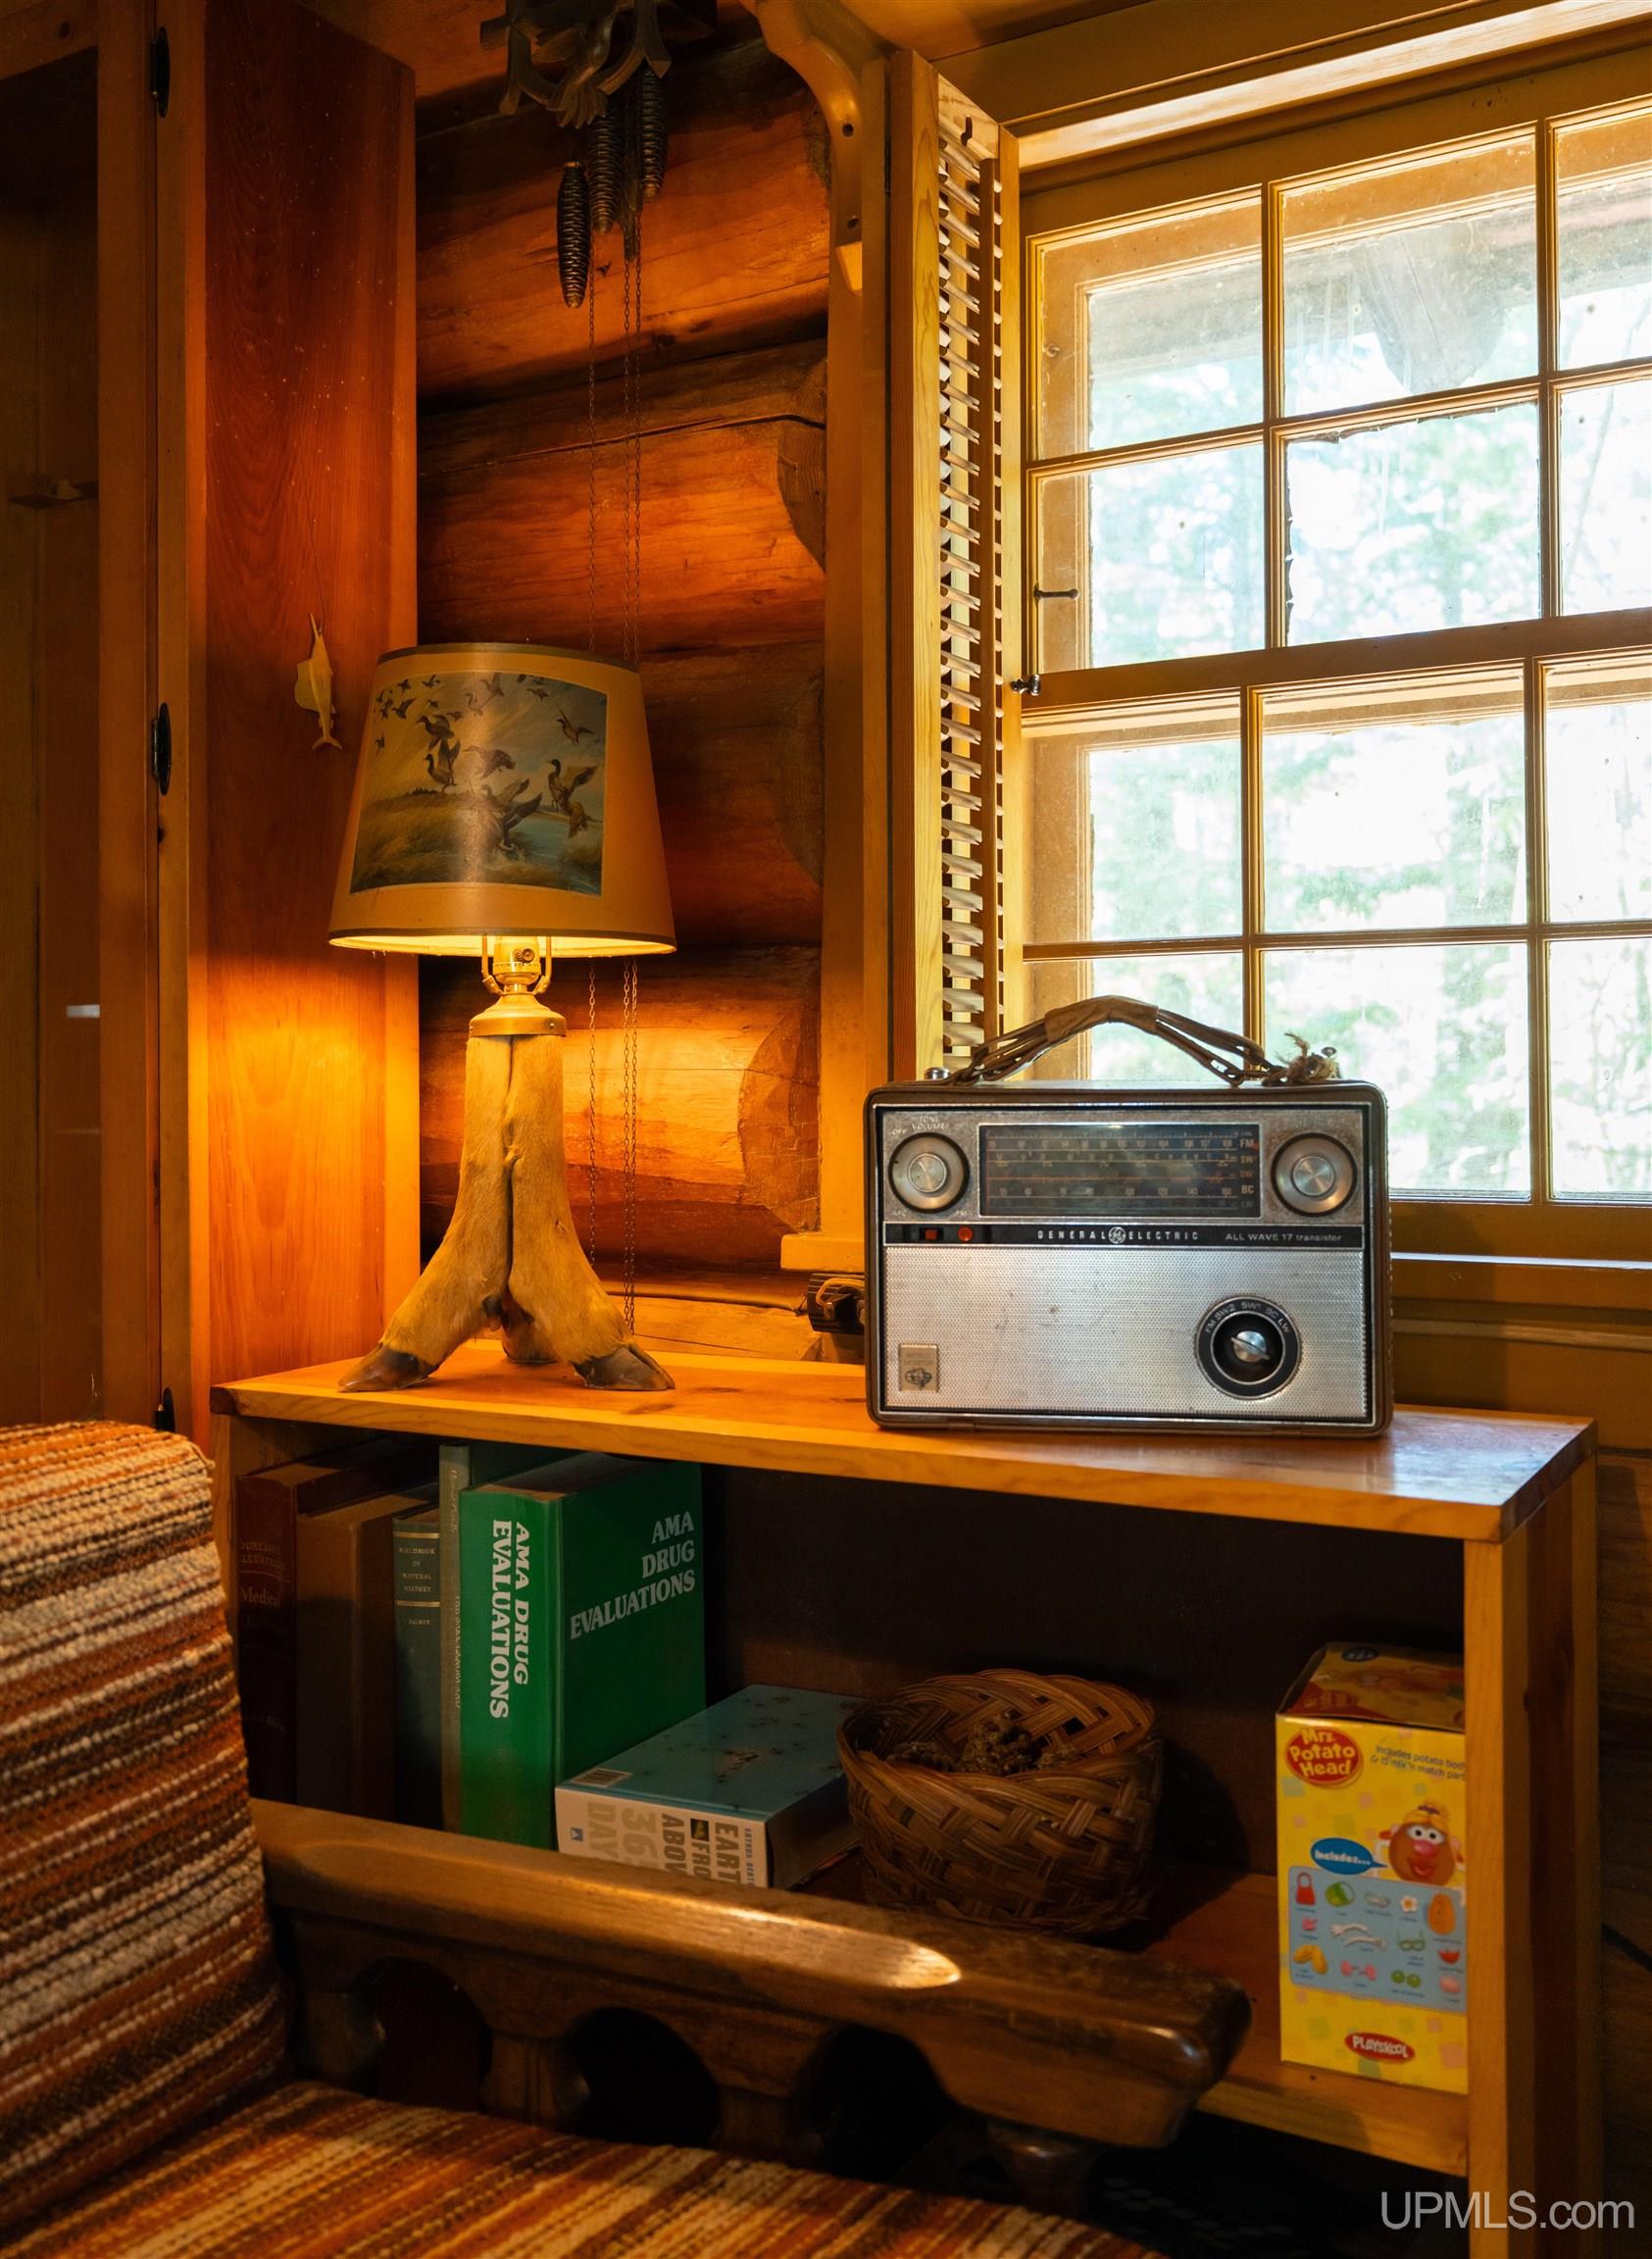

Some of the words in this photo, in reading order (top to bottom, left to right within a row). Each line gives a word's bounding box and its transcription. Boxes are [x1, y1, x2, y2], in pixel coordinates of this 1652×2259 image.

[1240, 1139, 1255, 1148] FM
[1241, 1184, 1255, 1194] BC
[1037, 1230, 1107, 1240] GENERAL
[1128, 1230, 1199, 1240] ELECTRIC
[1225, 1232, 1245, 1241] ALL
[1248, 1232, 1278, 1241] WAVE
[1296, 1233, 1342, 1242] transistor
[1277, 1318, 1291, 1333] LW
[650, 1511, 694, 1545] AMA
[398, 1546, 436, 1555] FIELDBOOK
[515, 1521, 530, 1591] AMA
[640, 1539, 695, 1579] DRUG
[411, 1560, 421, 1569] OF
[401, 1572, 432, 1581] NATURAL
[403, 1584, 432, 1593] HISTORY
[570, 1569, 696, 1640] EVALUATIONS
[490, 1519, 512, 1720] EVALUATIONS
[513, 1598, 530, 1686] DRUG
[1288, 1743, 1357, 1762] Potato
[1376, 1745, 1412, 1760] Includes
[1413, 1754, 1444, 1767] potato
[1299, 1760, 1351, 1778] Head
[1417, 1765, 1444, 1777] match
[662, 1813, 688, 1874] ABOV
[715, 1822, 742, 1883] EART
[691, 1841, 713, 1880] FRO
[1351, 2034, 1409, 2058] PLAYSKOOL
